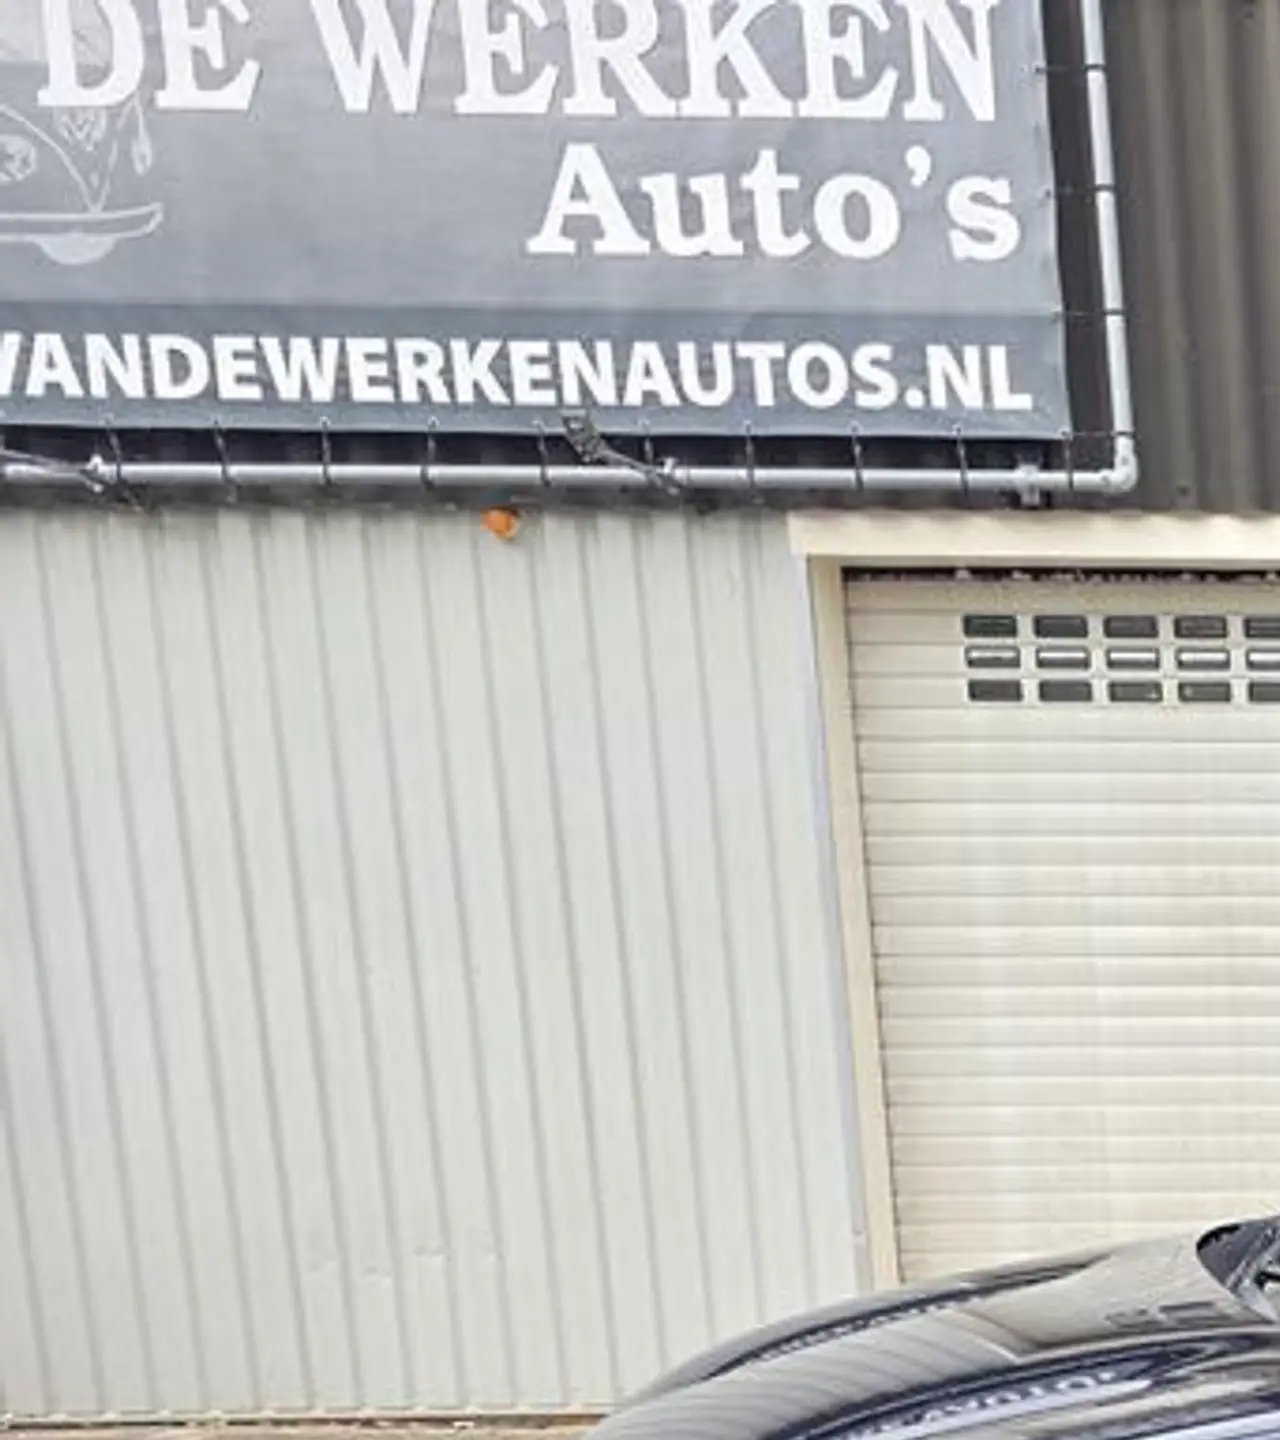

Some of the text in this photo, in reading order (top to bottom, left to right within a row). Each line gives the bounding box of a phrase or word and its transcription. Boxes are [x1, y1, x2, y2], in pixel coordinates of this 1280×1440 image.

[36, 0, 998, 122] DE WERKEN
[526, 143, 1021, 262] Auto's
